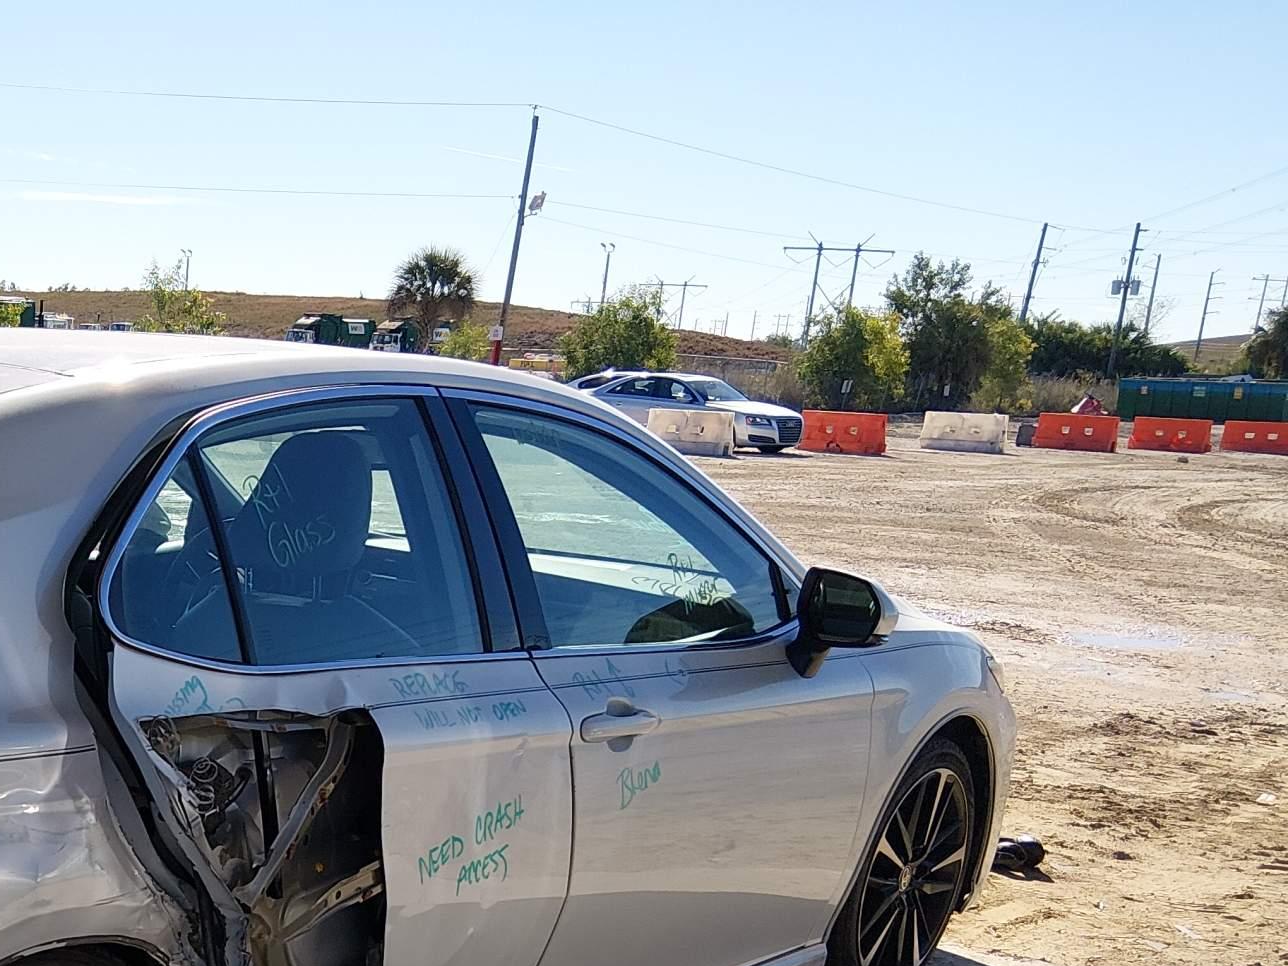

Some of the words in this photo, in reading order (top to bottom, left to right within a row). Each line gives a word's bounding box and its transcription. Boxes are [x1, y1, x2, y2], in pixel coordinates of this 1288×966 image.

[267, 512, 336, 568] Glass
[492, 698, 527, 722] OPEN
[418, 834, 465, 886] NEED
[475, 793, 525, 846] CRASH
